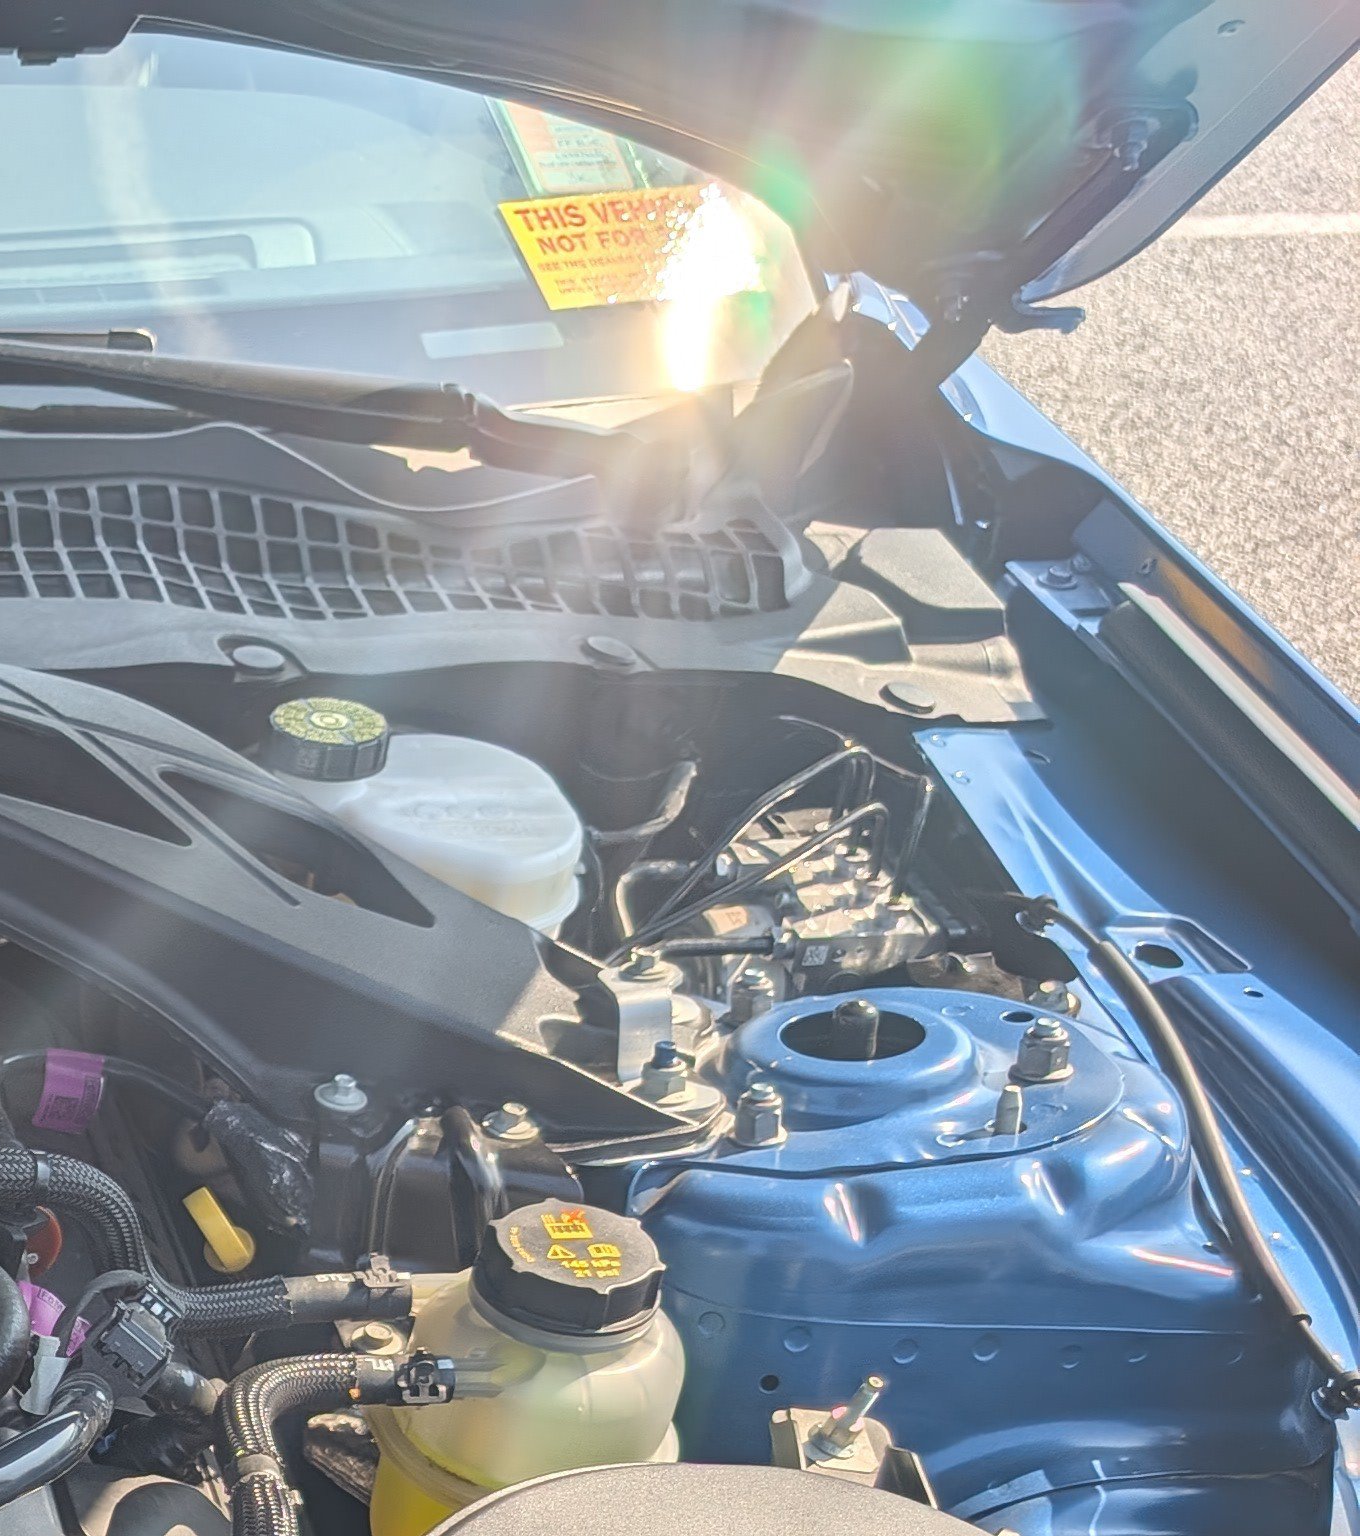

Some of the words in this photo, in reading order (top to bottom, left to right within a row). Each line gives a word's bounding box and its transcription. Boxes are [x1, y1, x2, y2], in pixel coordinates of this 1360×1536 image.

[514, 204, 586, 232] THIS
[537, 233, 587, 255] NOT
[595, 227, 646, 249] FOR
